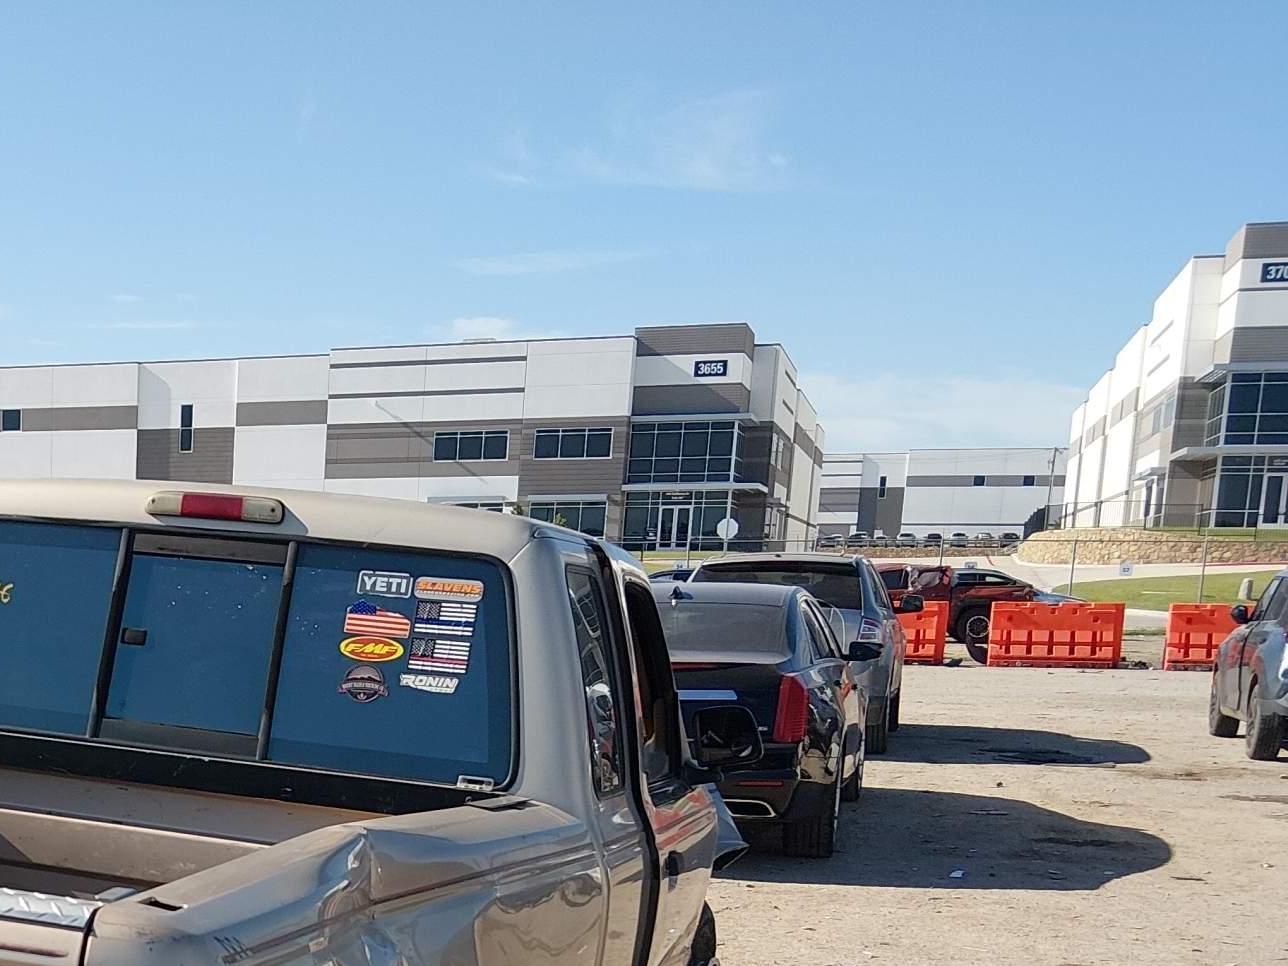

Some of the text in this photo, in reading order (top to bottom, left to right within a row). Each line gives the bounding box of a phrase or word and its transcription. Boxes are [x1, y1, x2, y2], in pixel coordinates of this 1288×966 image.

[697, 362, 724, 375] 3655
[363, 575, 407, 593] YETI
[417, 580, 481, 594] SLAVENS
[345, 643, 399, 654] FMF
[402, 674, 457, 689] RONIN
